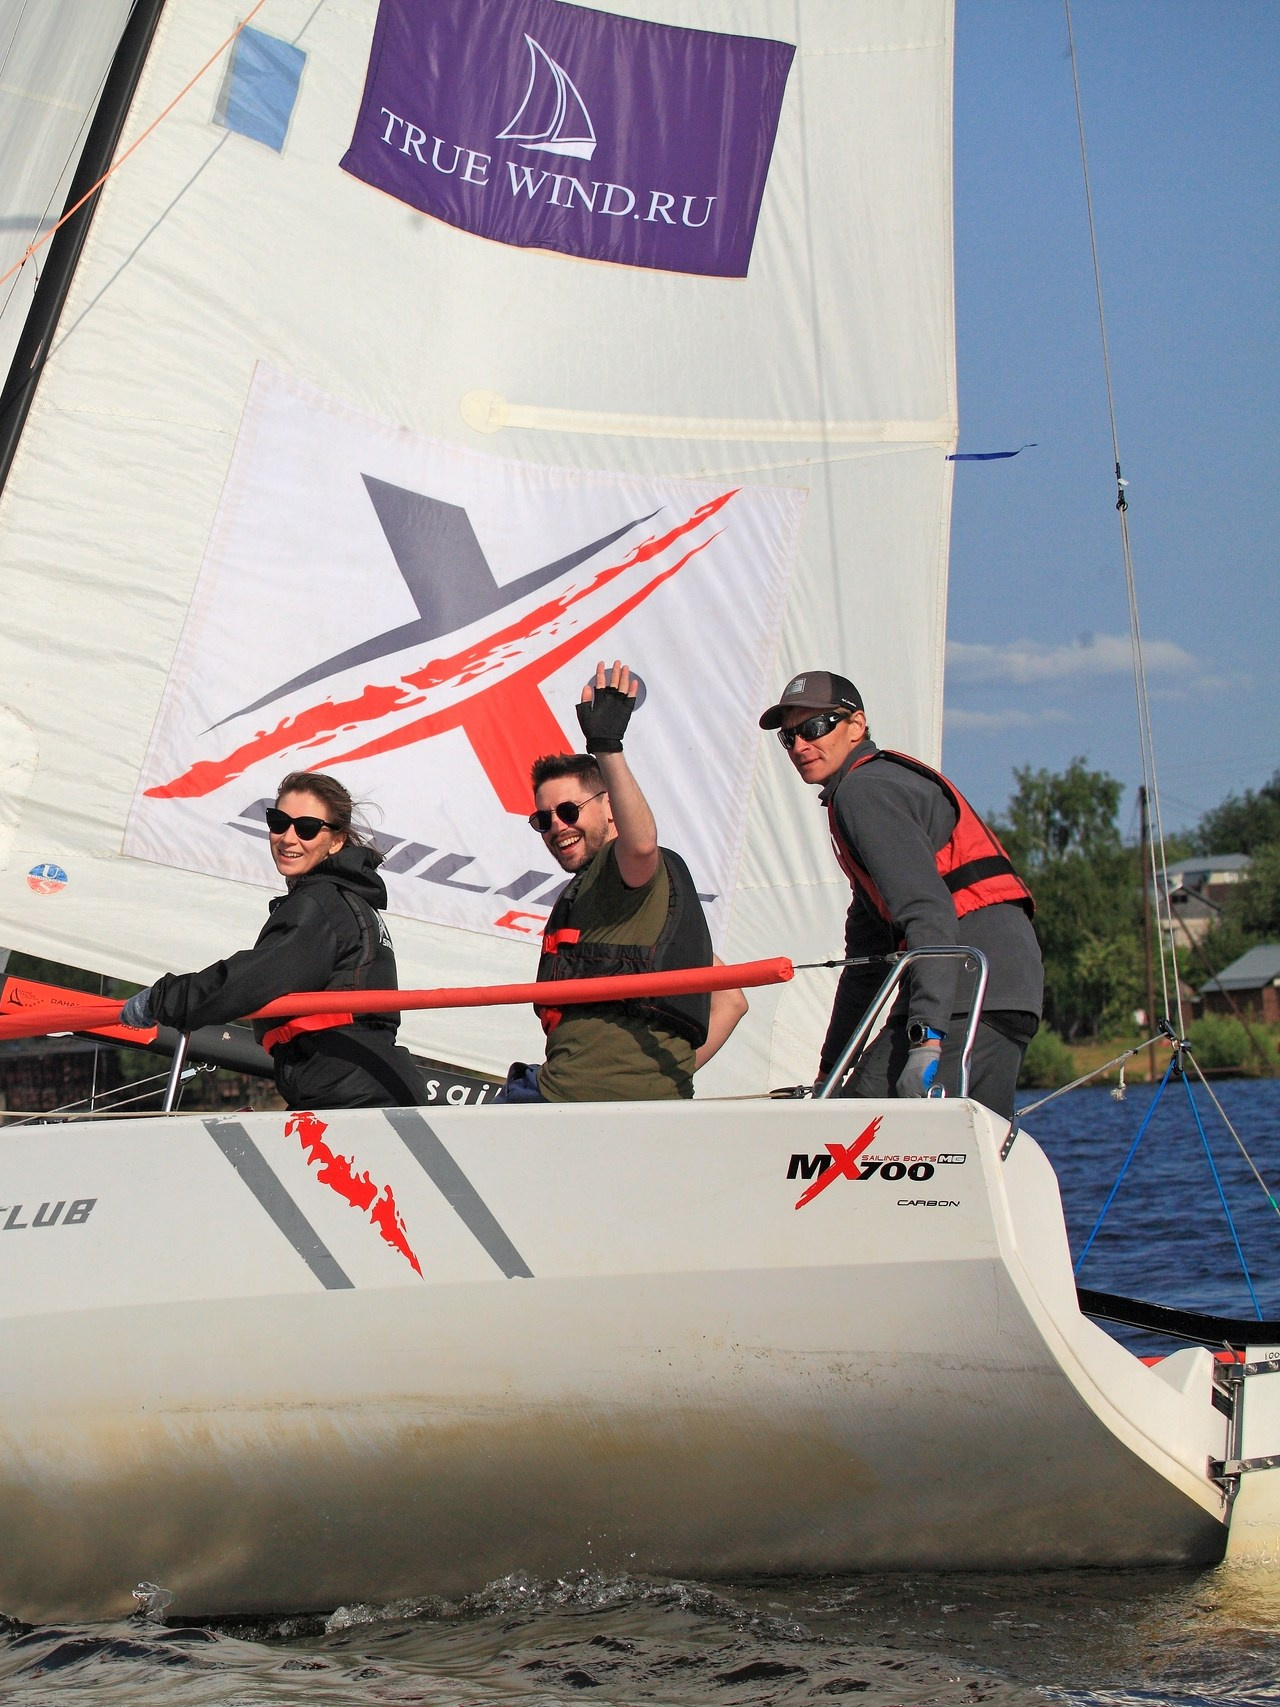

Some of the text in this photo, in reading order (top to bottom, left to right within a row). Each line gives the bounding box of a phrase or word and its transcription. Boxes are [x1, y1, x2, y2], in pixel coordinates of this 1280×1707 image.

[380, 106, 717, 228] TRUE WIND.RU
[861, 1154, 966, 1164] SAILING BOATS MG
[896, 1199, 961, 1207] CARBON
